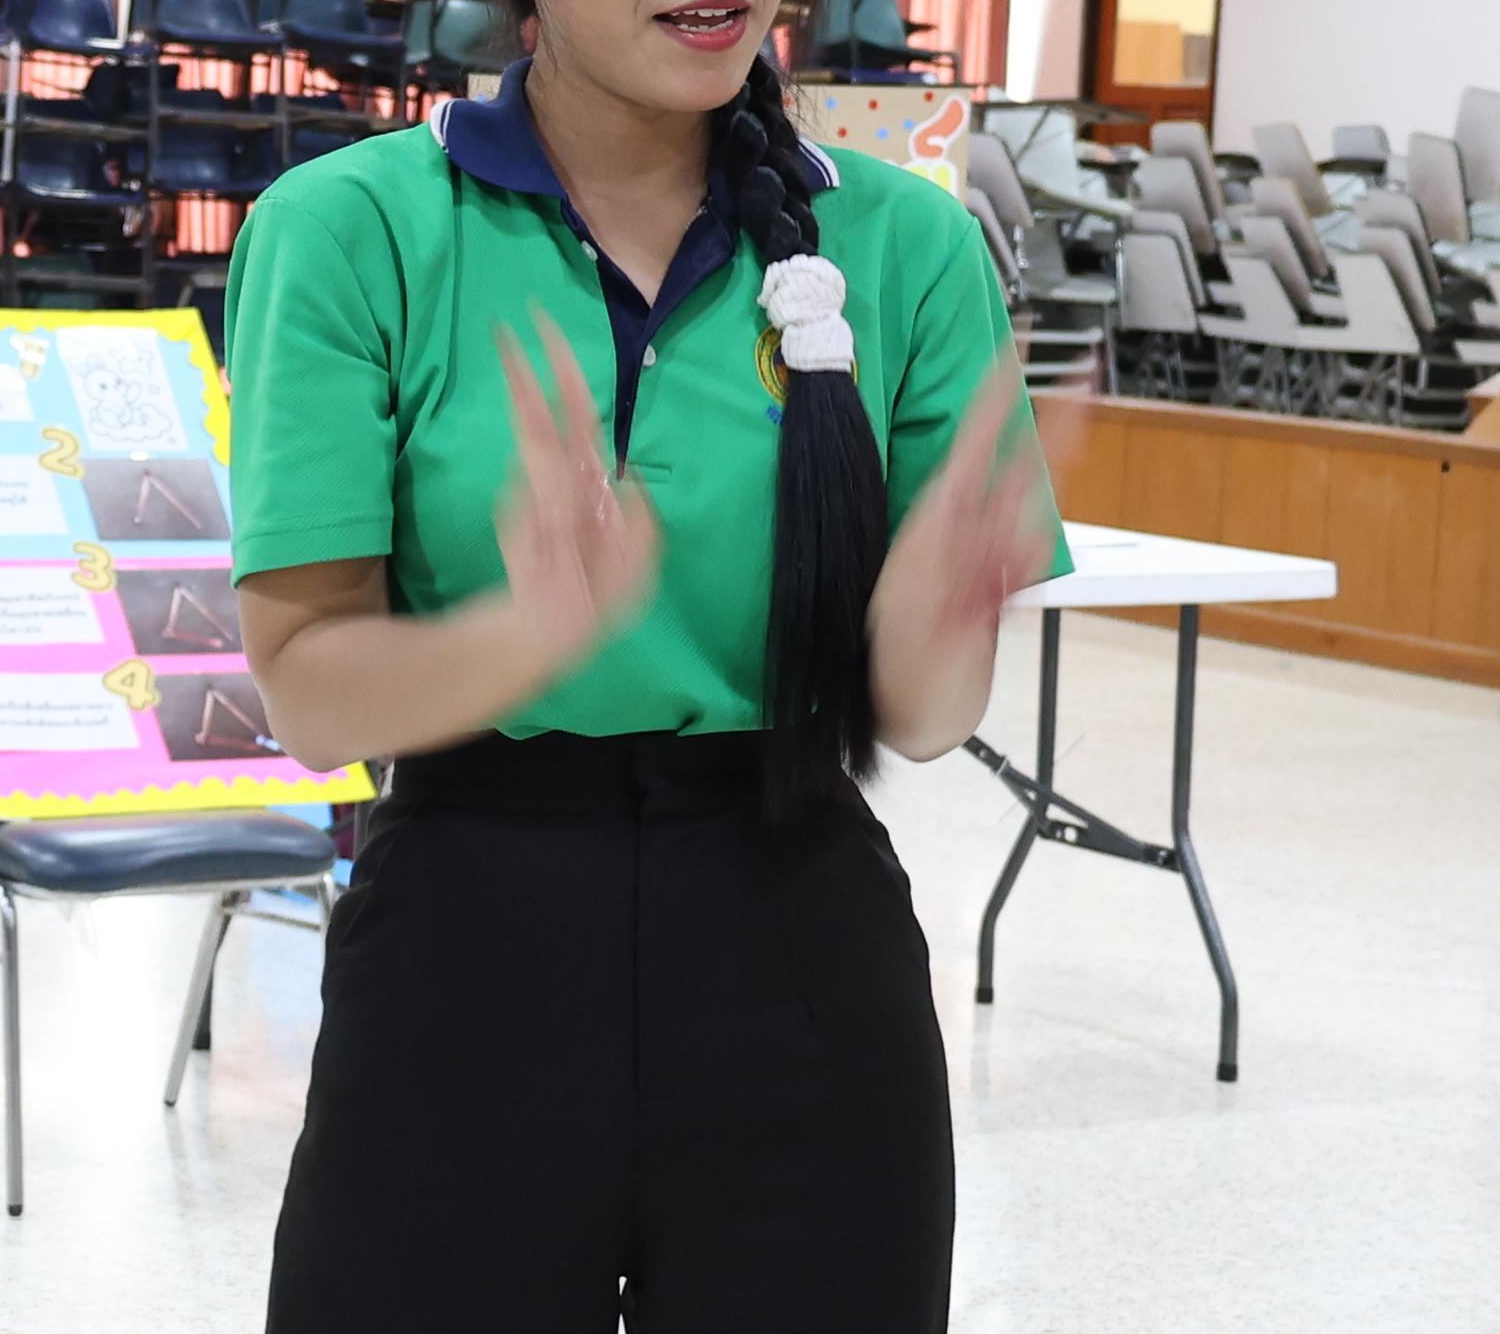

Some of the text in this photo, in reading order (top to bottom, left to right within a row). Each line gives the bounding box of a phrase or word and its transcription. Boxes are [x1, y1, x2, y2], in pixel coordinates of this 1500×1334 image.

[39, 427, 83, 478] 2
[72, 542, 116, 590] 3
[103, 659, 159, 711] 4
